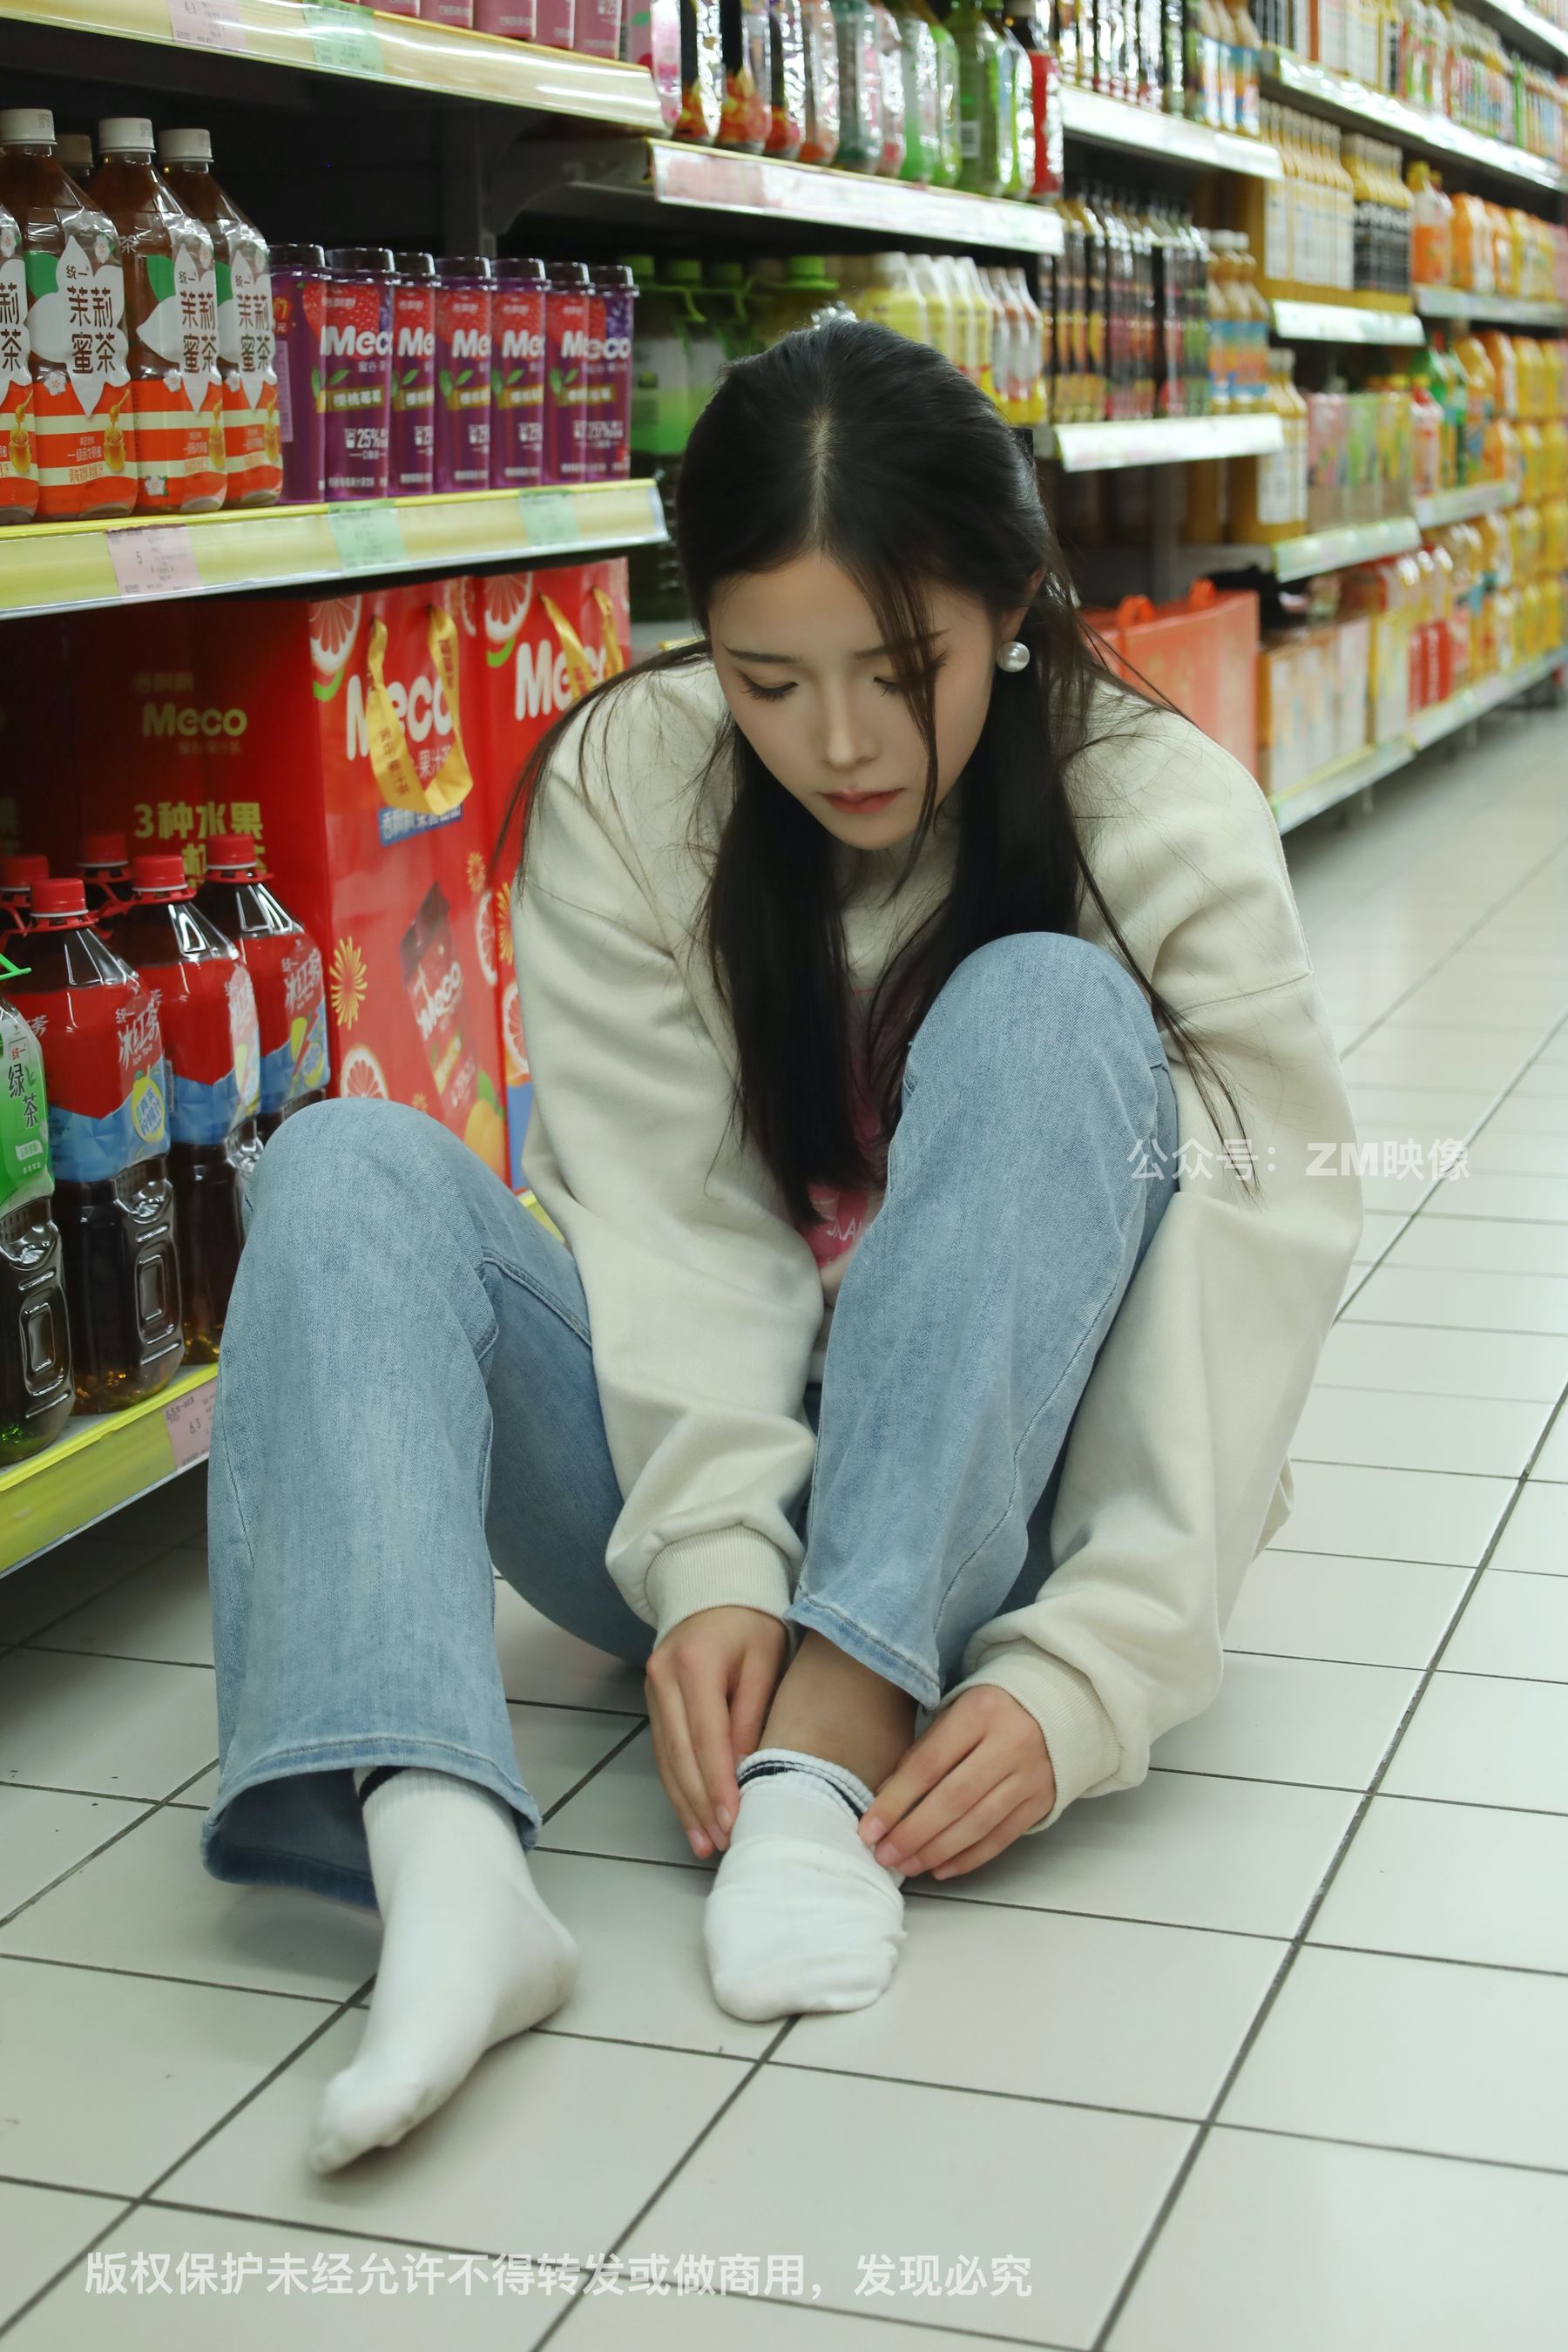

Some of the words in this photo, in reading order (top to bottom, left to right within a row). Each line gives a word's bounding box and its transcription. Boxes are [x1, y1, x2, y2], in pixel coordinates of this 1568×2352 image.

[65, 265, 88, 280] 统一
[179, 271, 196, 285] 统一
[67, 286, 113, 328] 茉莉
[179, 290, 216, 330] 茉莉
[236, 294, 269, 331] 茉莉
[71, 332, 116, 375] 蜜茶
[183, 334, 217, 374] 蜜茶
[240, 334, 271, 373] 蜜茶
[142, 701, 248, 737] Meco
[133, 801, 264, 840] 3种水果
[116, 1007, 136, 1024] 统一
[419, 961, 463, 1041] Meco
[11, 1045, 27, 1060] 统一
